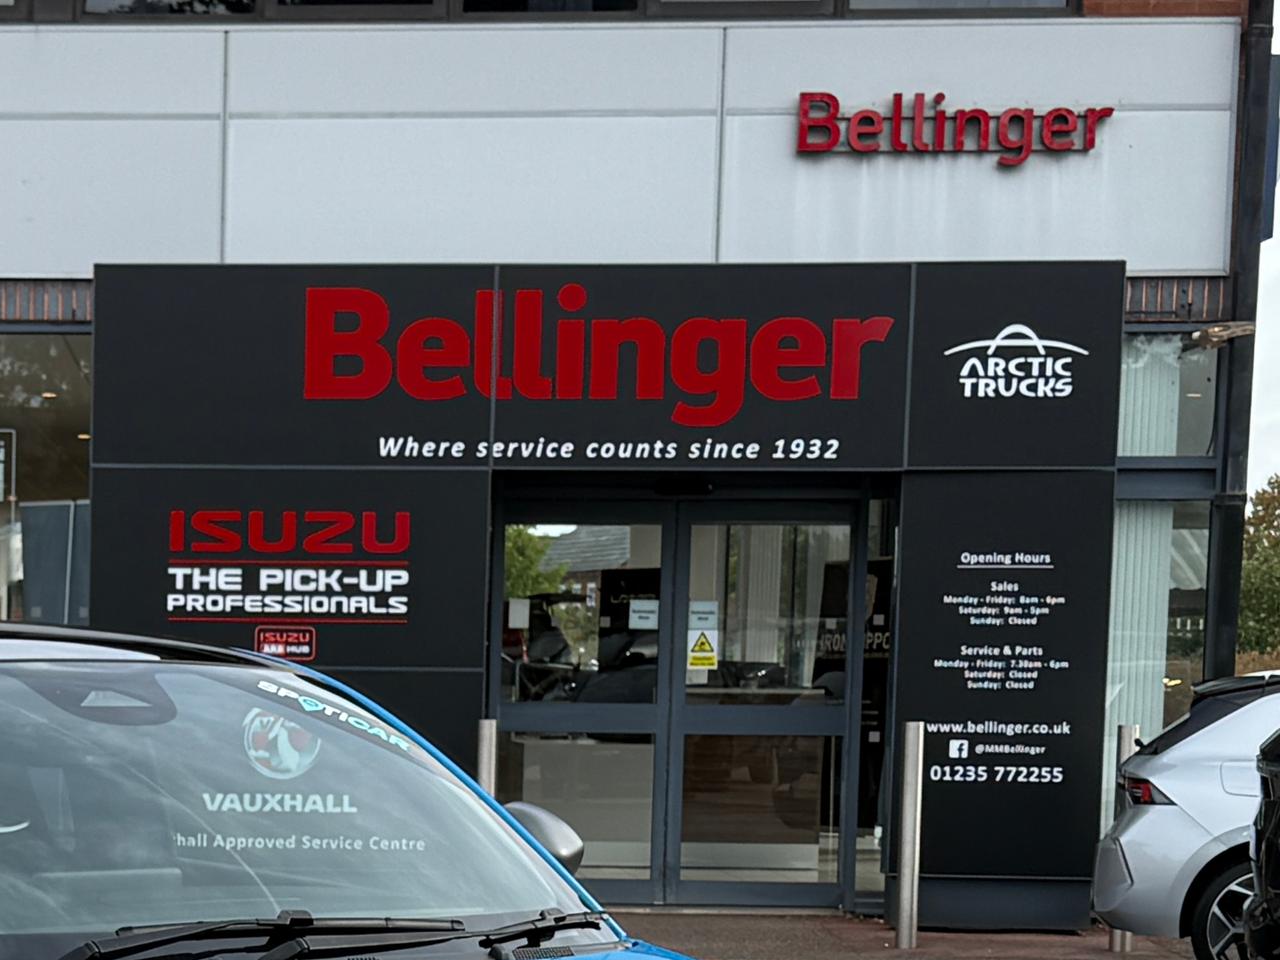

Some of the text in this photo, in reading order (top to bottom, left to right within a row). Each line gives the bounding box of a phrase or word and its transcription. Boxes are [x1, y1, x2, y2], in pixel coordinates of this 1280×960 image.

[796, 92, 1114, 167] Bellinger
[304, 283, 894, 428] Bellinger
[960, 357, 1072, 377] ARCTIC
[959, 377, 1073, 397] TRUCKS
[379, 437, 840, 459] Where service counts since 1932
[169, 511, 410, 553] ISUZU
[960, 552, 1051, 565] Opening Hours
[168, 568, 409, 592] THE PICK-UP
[990, 581, 1019, 592] Sales
[167, 594, 408, 614] PROFESSIONALS
[943, 595, 978, 605] Monday
[1008, 616, 1038, 626] Closed
[260, 631, 310, 643] ISUZU
[960, 645, 1043, 656] Service & Parts
[1009, 670, 1038, 679] Closed
[1005, 681, 1034, 690] Closed
[926, 720, 1071, 736] www.bellinger.co.uk
[975, 744, 1046, 755] @MMBellinger
[930, 765, 1064, 783] 01235 772255
[202, 793, 358, 813] VAUXHALL
[173, 833, 426, 851] hall Approved Service Centre
